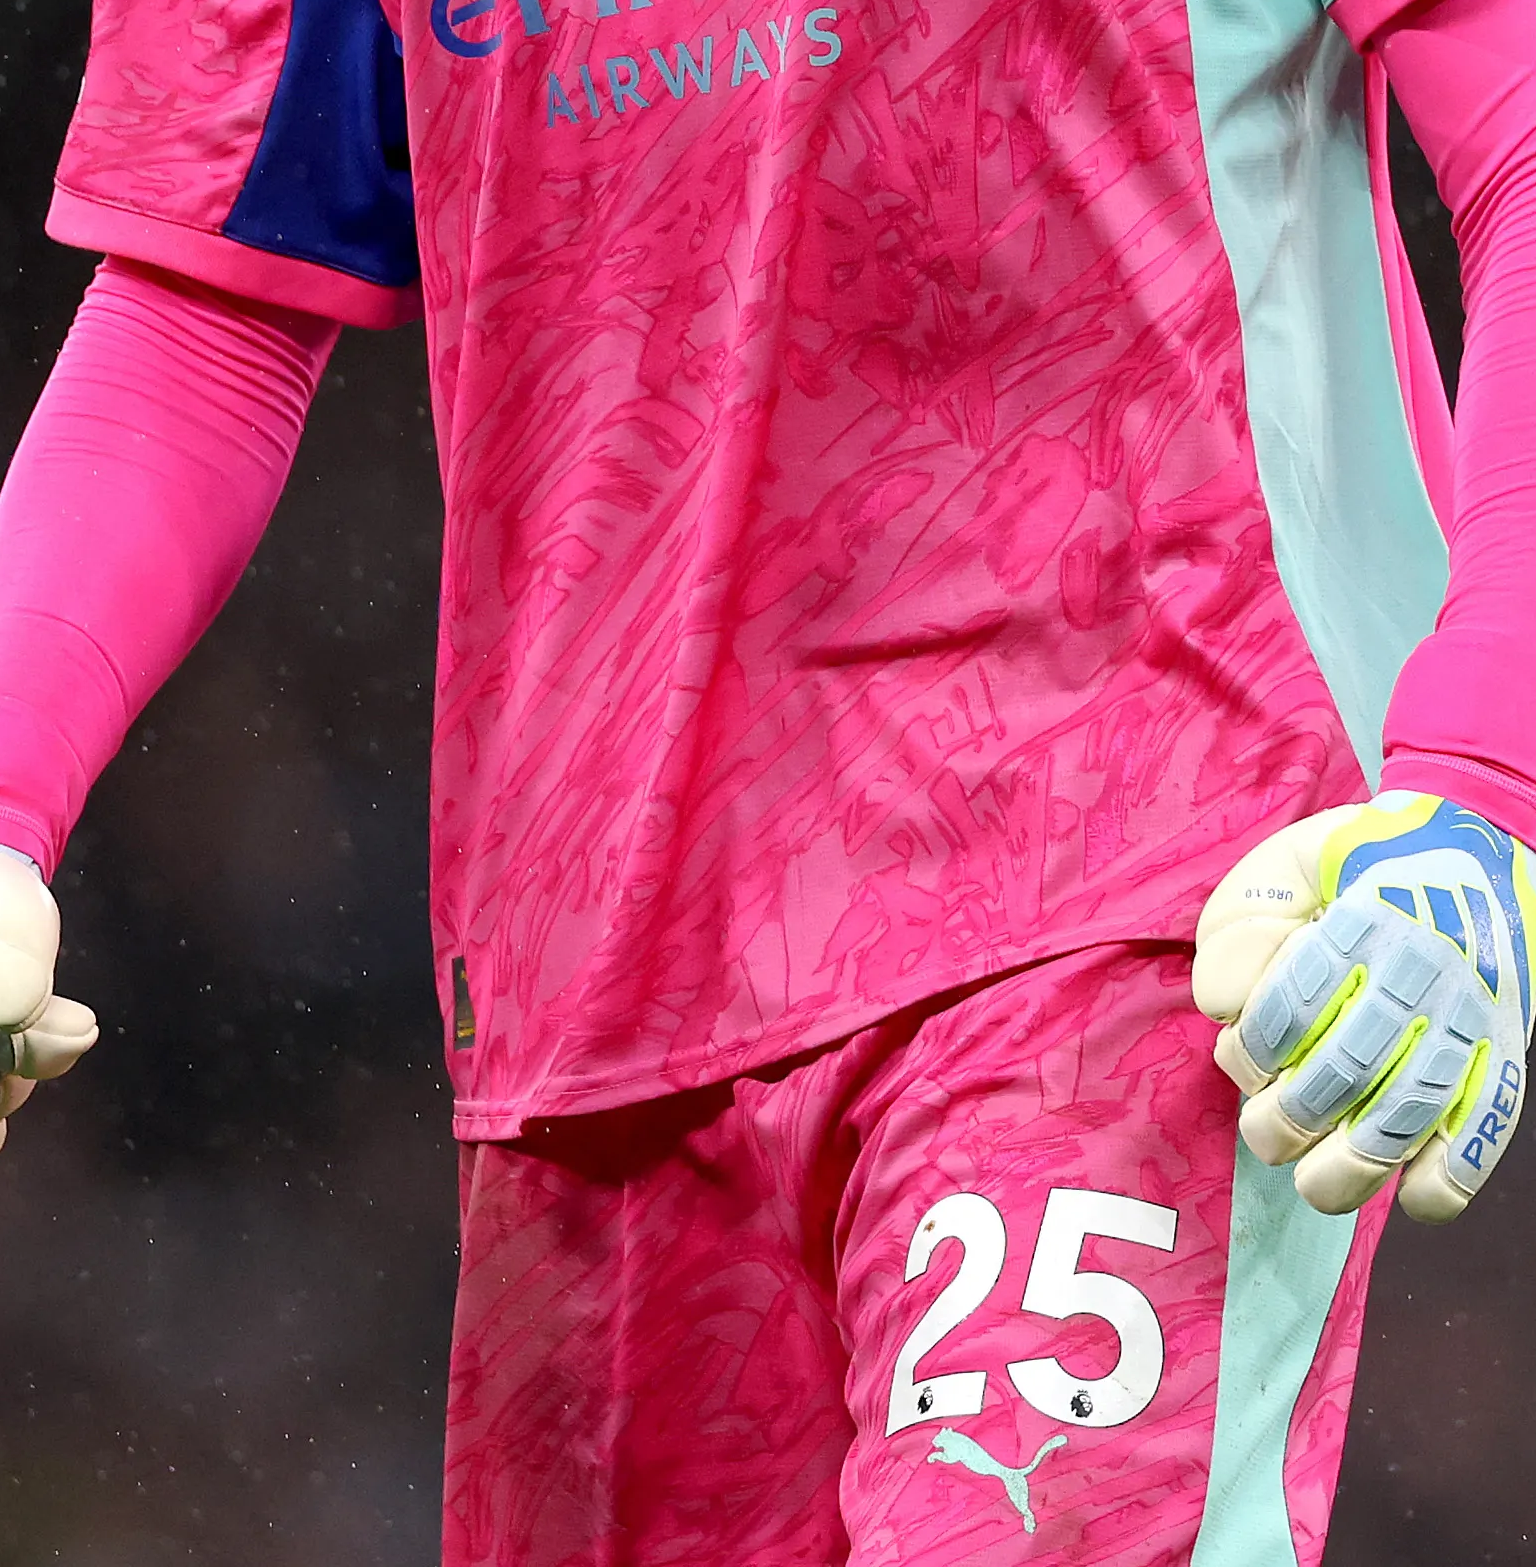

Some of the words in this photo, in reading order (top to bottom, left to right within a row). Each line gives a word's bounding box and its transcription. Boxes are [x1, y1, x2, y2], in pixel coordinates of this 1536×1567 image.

[545, 7, 844, 129] AIRWAYS
[1267, 887, 1294, 902] URG
[1461, 1059, 1521, 1171] PRED
[885, 1187, 1179, 1438] 25
